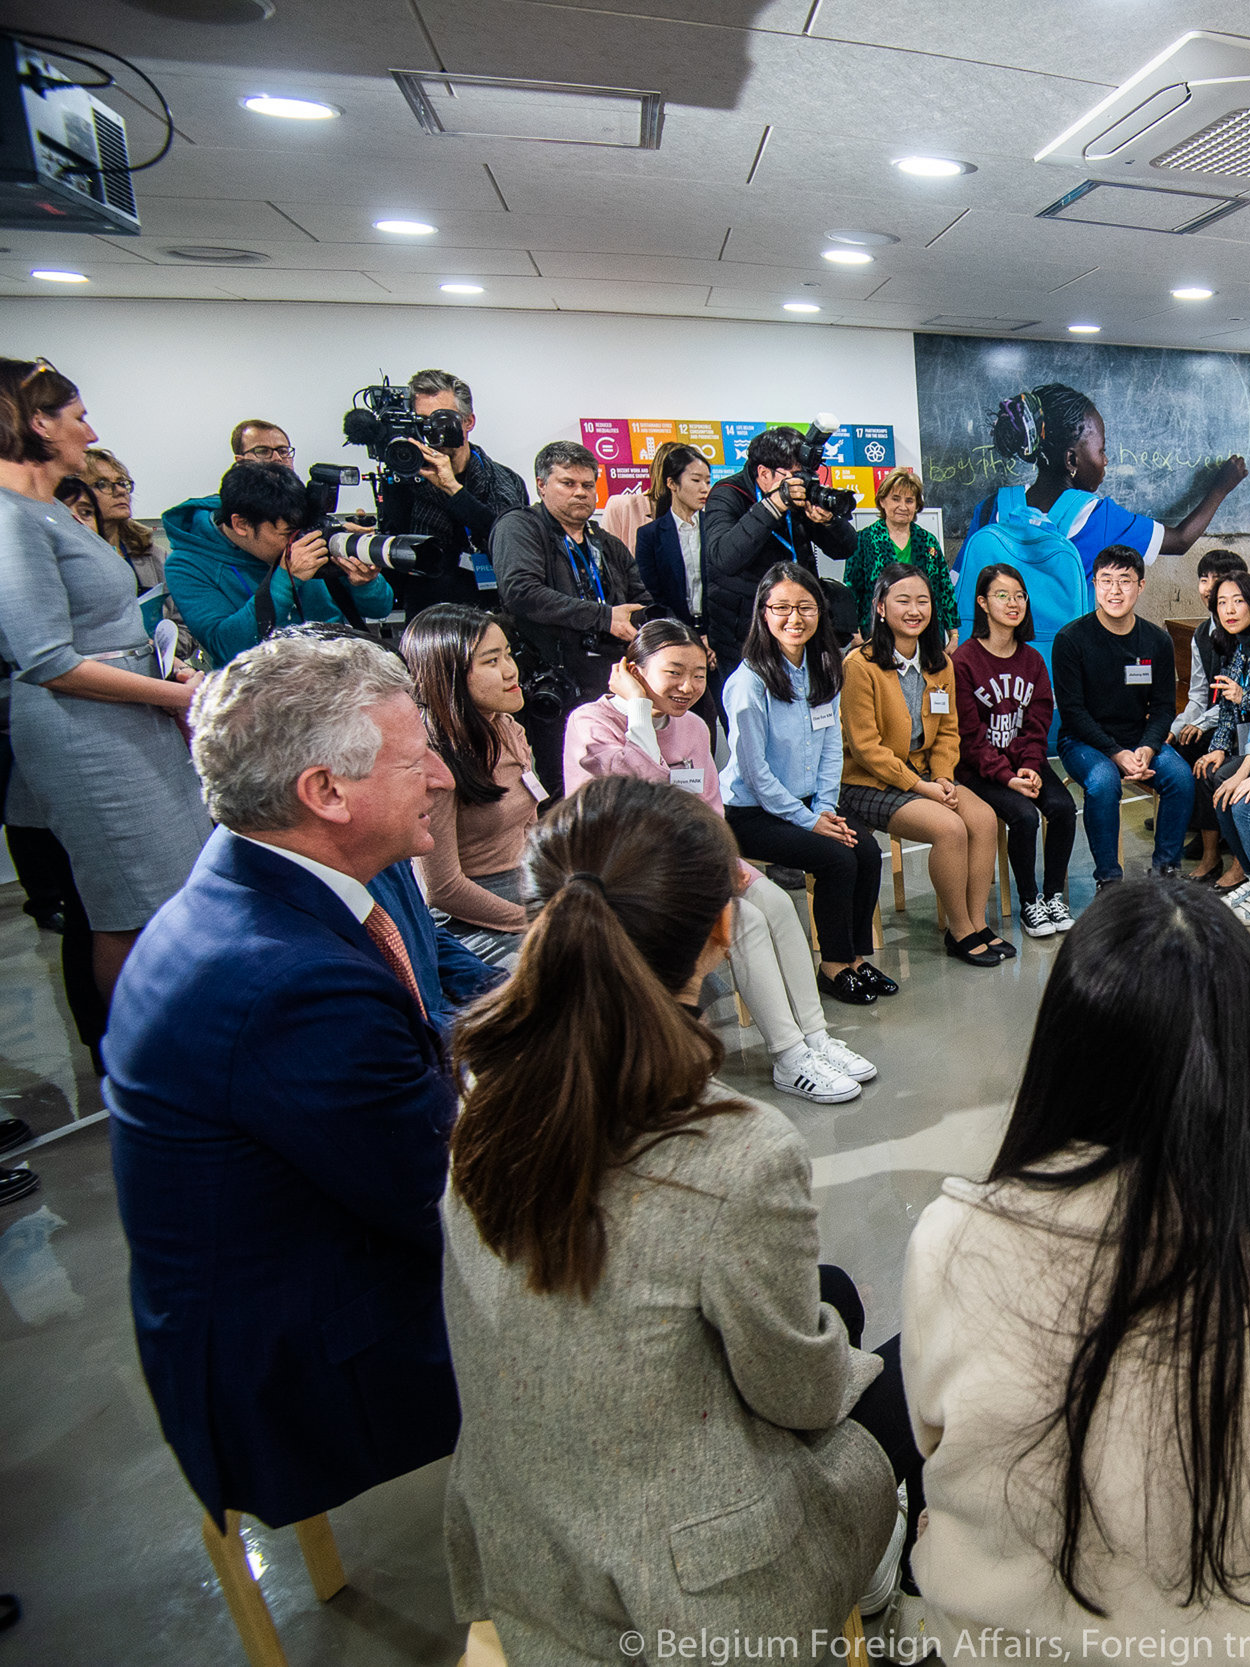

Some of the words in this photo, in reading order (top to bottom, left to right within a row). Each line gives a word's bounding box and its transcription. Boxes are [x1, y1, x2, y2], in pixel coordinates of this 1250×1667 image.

[583, 422, 594, 433] 10
[631, 422, 640, 433] 11
[679, 424, 688, 434] 12
[725, 425, 735, 435] 14
[856, 428, 863, 438] 17
[610, 468, 617, 479] 8
[835, 470, 841, 479] 2
[877, 471, 882, 480] 1
